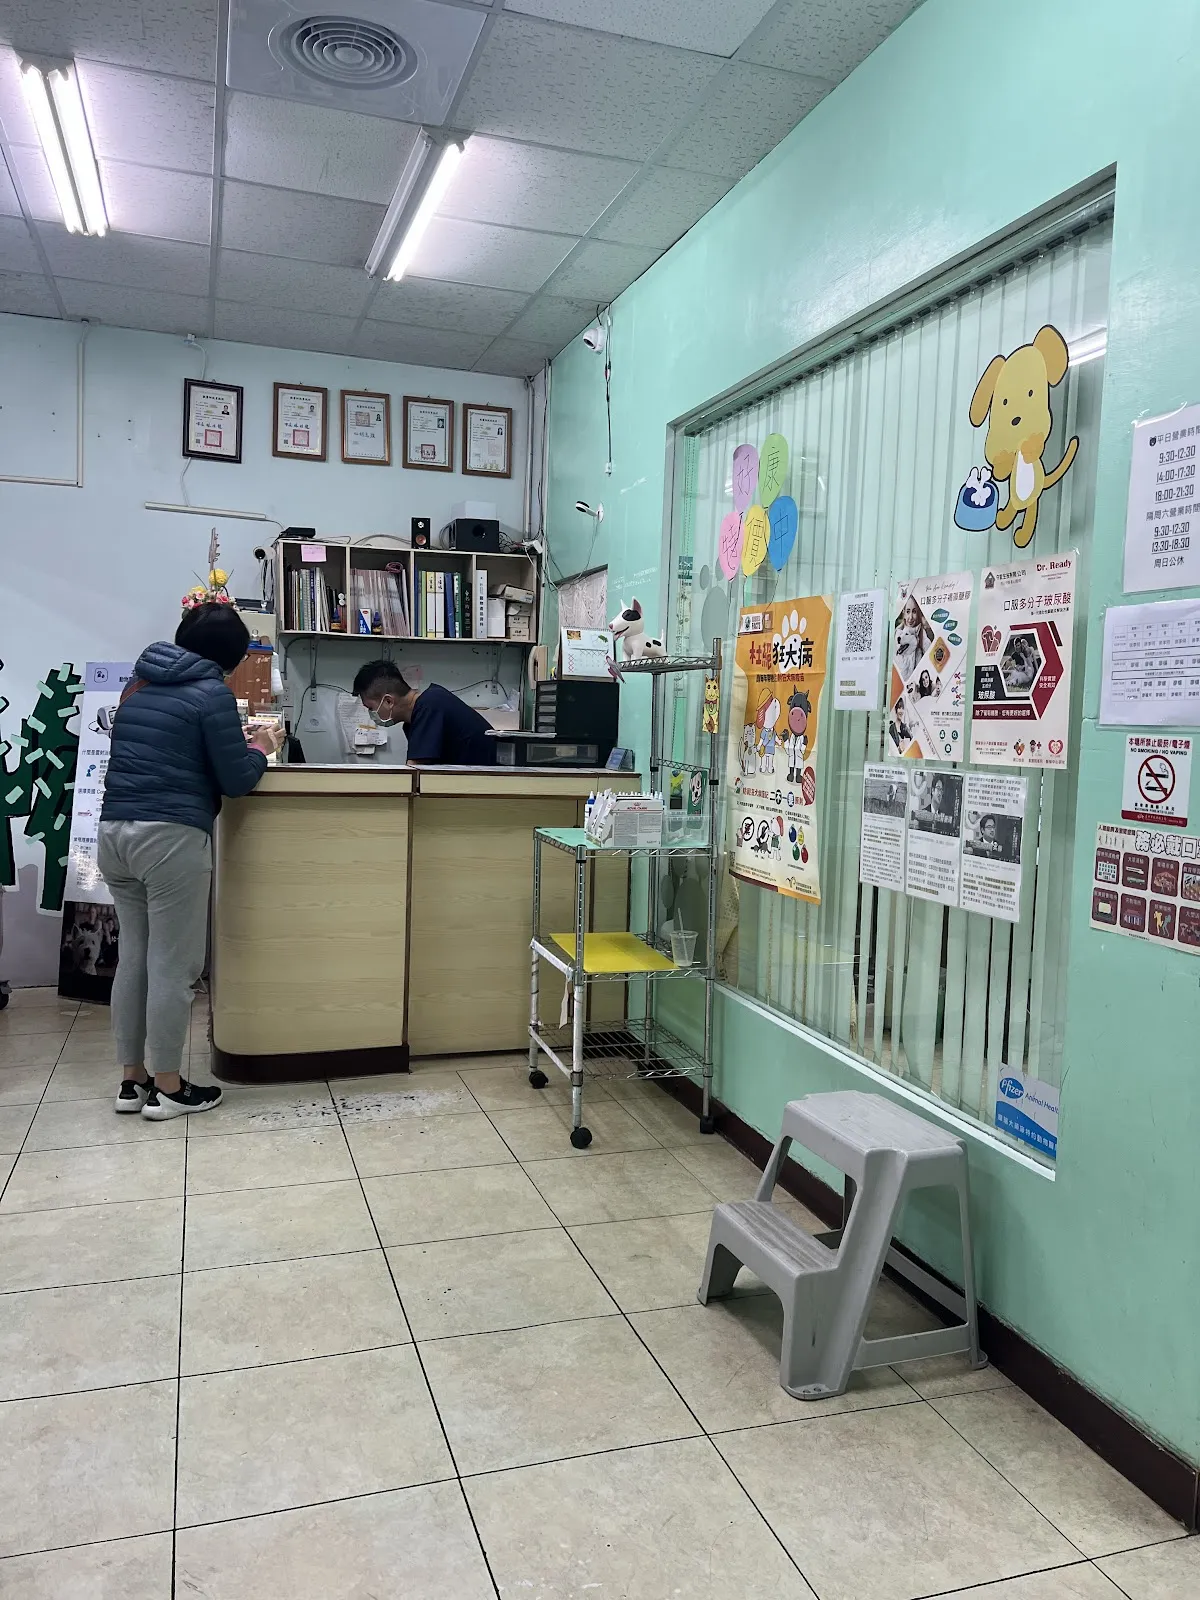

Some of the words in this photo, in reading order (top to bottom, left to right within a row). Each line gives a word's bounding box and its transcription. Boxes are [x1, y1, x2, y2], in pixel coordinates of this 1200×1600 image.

[1159, 445, 1196, 463] 9:30-12:30
[1156, 465, 1196, 483] 14:00-17:30
[1155, 484, 1194, 502] 18:00-21:30
[1154, 522, 1190, 537] 9:30-12:30
[1152, 537, 1190, 552] 13:30-18:30
[1036, 563, 1048, 572] Dr.
[1050, 559, 1072, 570] Ready
[1154, 556, 1185, 568] 周日公休
[1003, 592, 1072, 611] 口服多分子玻尿酸
[749, 638, 814, 670] 杜絕狂犬病
[978, 691, 996, 699] 玻尿酸
[1135, 830, 1200, 859] 務必戴口
[1001, 1079, 1024, 1096] Pfizer
[1025, 1092, 1044, 1107] Animal
